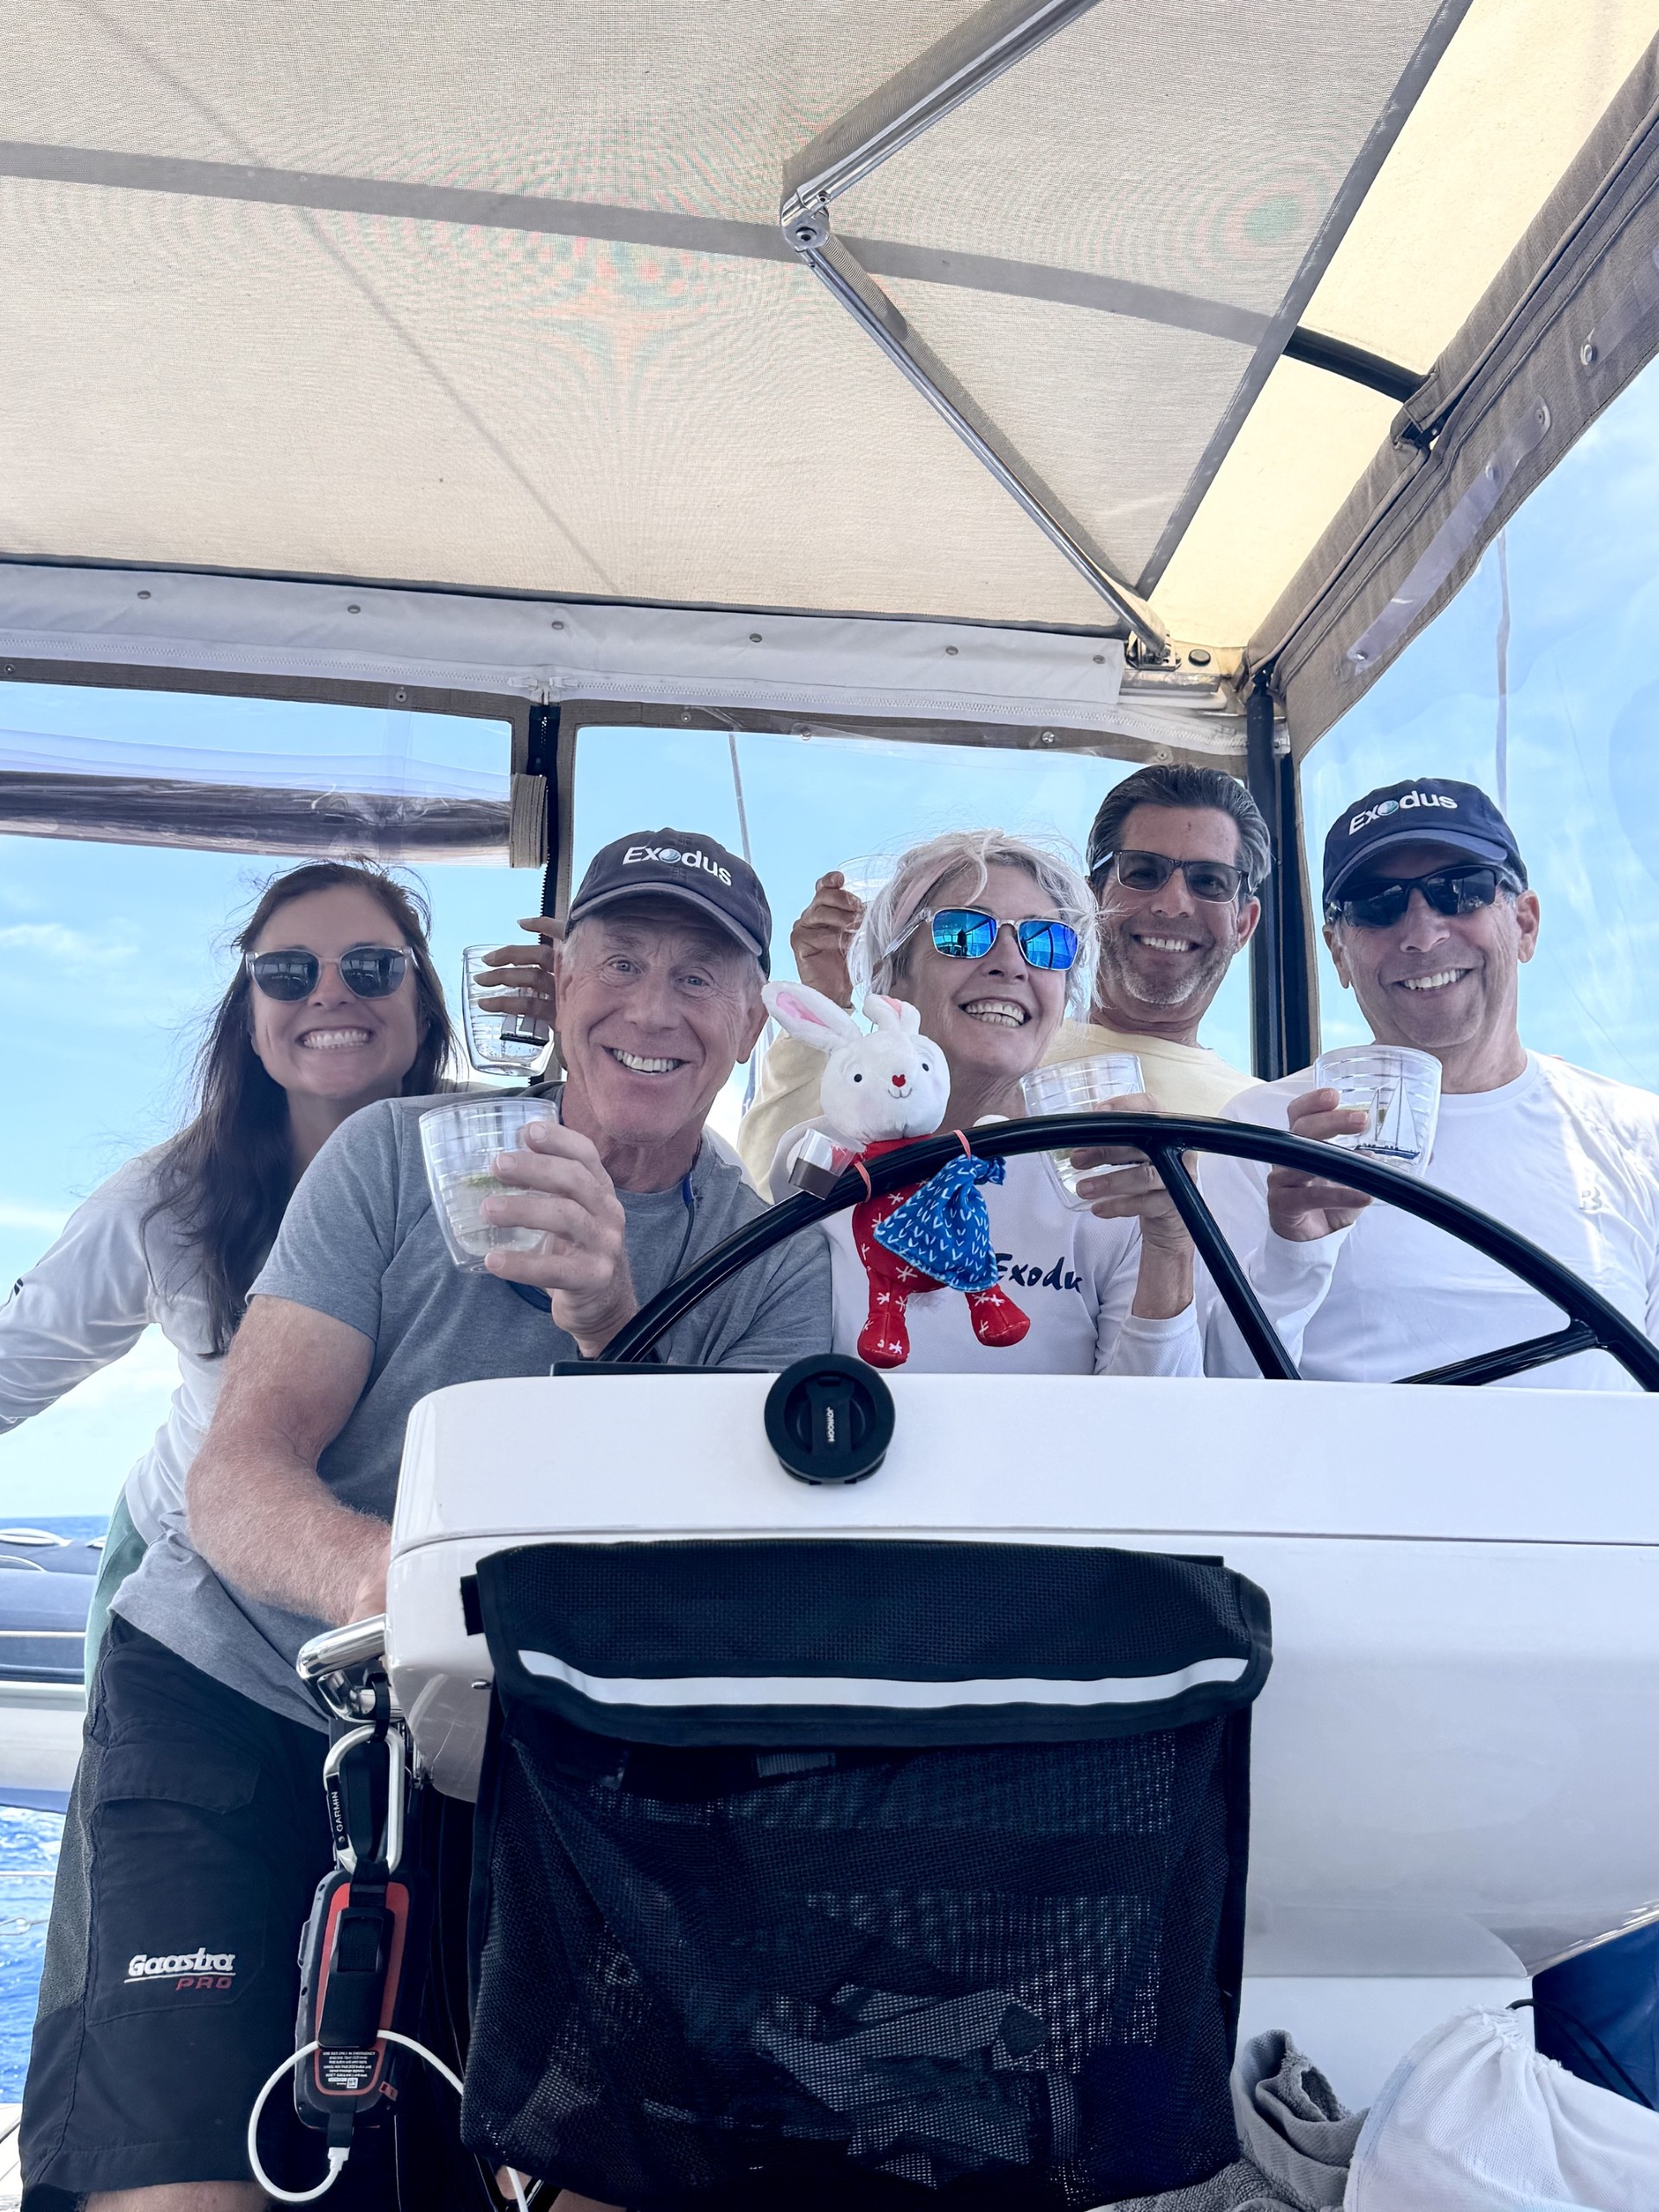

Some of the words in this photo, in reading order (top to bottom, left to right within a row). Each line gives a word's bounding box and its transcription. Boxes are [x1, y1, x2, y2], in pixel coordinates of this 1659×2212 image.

[1348, 790, 1459, 836] Exodus
[622, 845, 732, 887] Exodus
[995, 1253, 1083, 1294] Exodu
[331, 1791, 343, 1832] GARMIN
[128, 1947, 236, 1977] Gaastra
[175, 1976, 232, 1991] PRO
